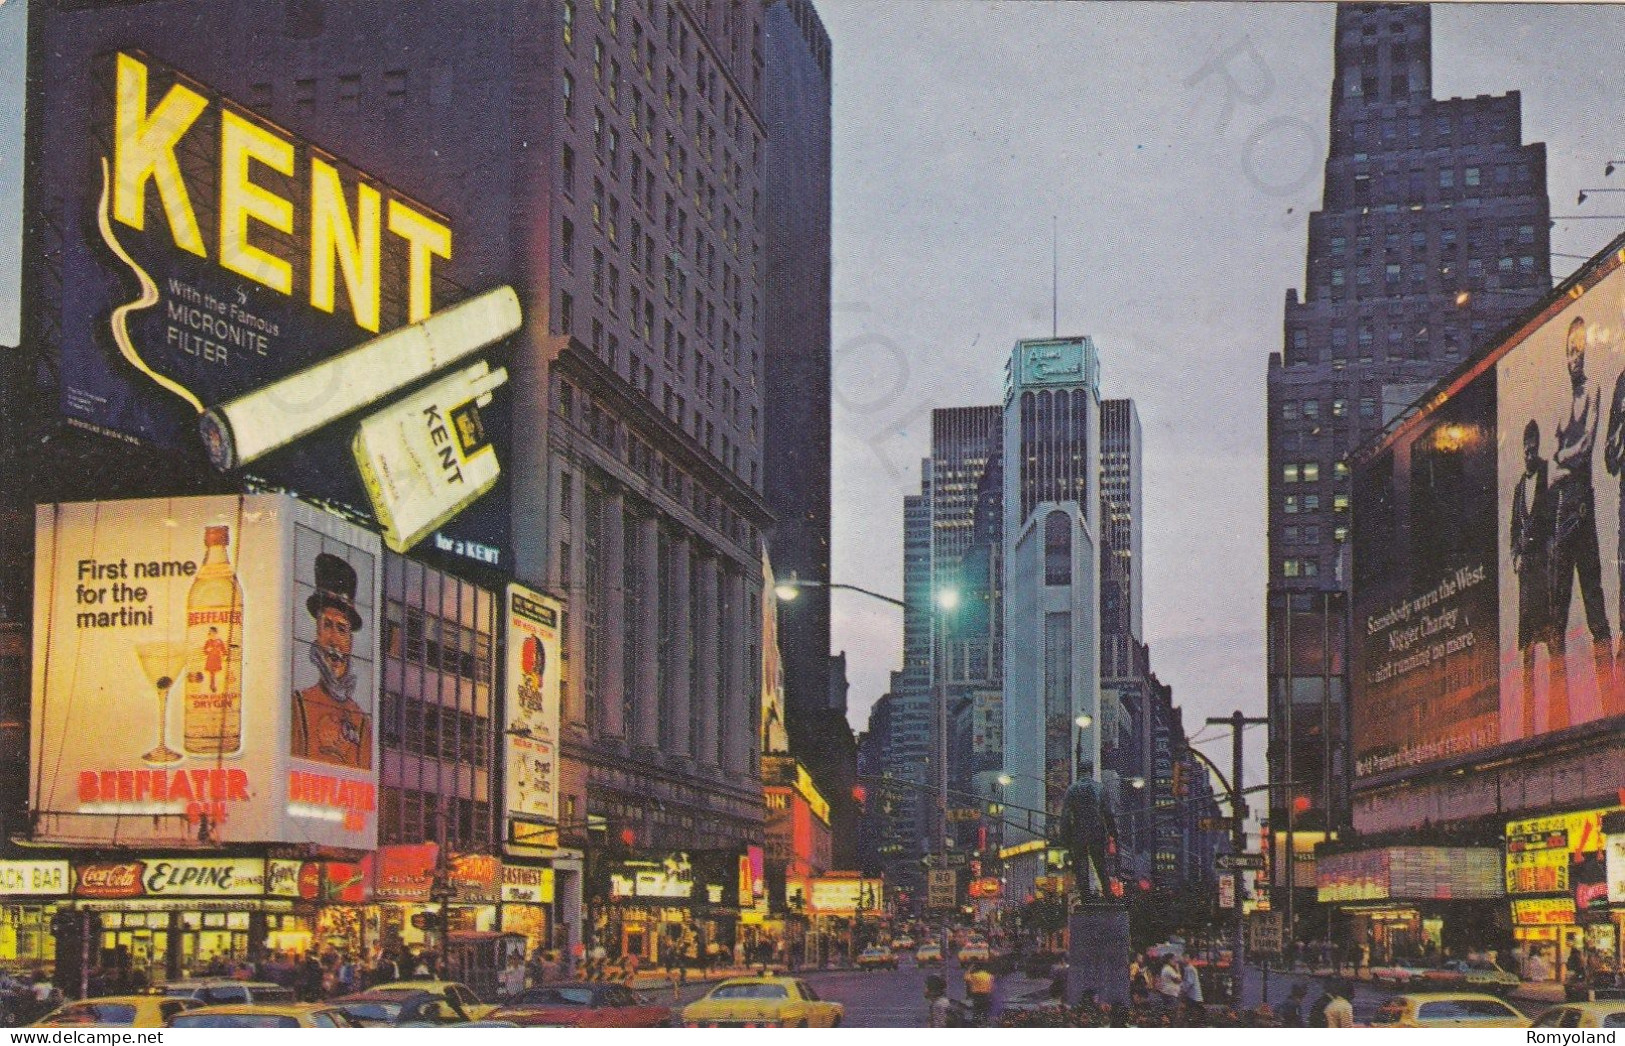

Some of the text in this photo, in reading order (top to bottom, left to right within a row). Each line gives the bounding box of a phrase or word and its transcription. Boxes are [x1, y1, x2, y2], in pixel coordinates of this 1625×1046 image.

[113, 51, 452, 334] KENT
[168, 278, 280, 337] With the Famous
[167, 300, 268, 356] MICRONITE
[167, 326, 228, 364] FILTER
[422, 404, 465, 485] KENT
[77, 558, 197, 580] First name
[76, 582, 148, 604] for the
[1439, 578, 1456, 600] the
[76, 605, 153, 628] martini
[188, 610, 242, 626] BEEFEATER
[78, 769, 250, 803] BEEFEATER
[32, 866, 63, 889] BAR
